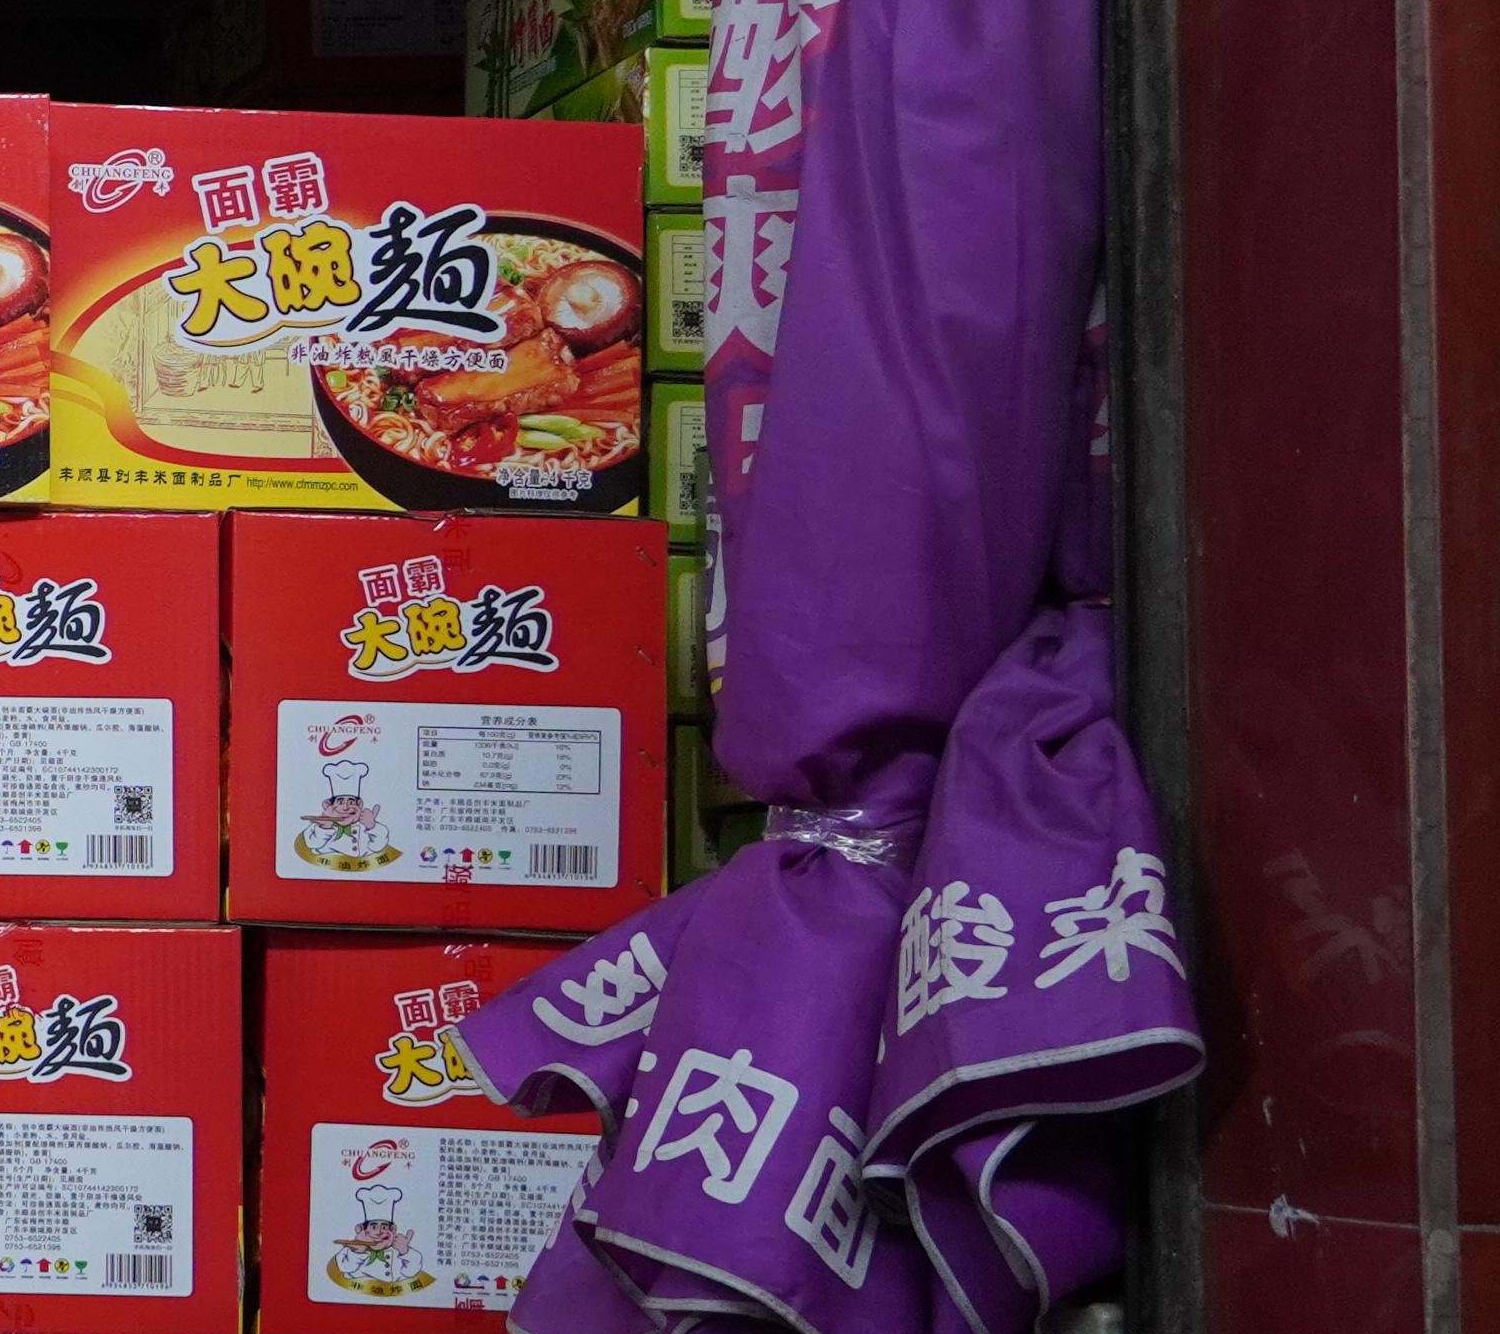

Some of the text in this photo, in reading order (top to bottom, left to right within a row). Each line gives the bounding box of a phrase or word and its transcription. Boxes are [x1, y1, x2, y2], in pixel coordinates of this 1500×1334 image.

[198, 158, 326, 227] 面霸
[170, 208, 499, 335] 大碗麵
[362, 557, 442, 602] 面霸
